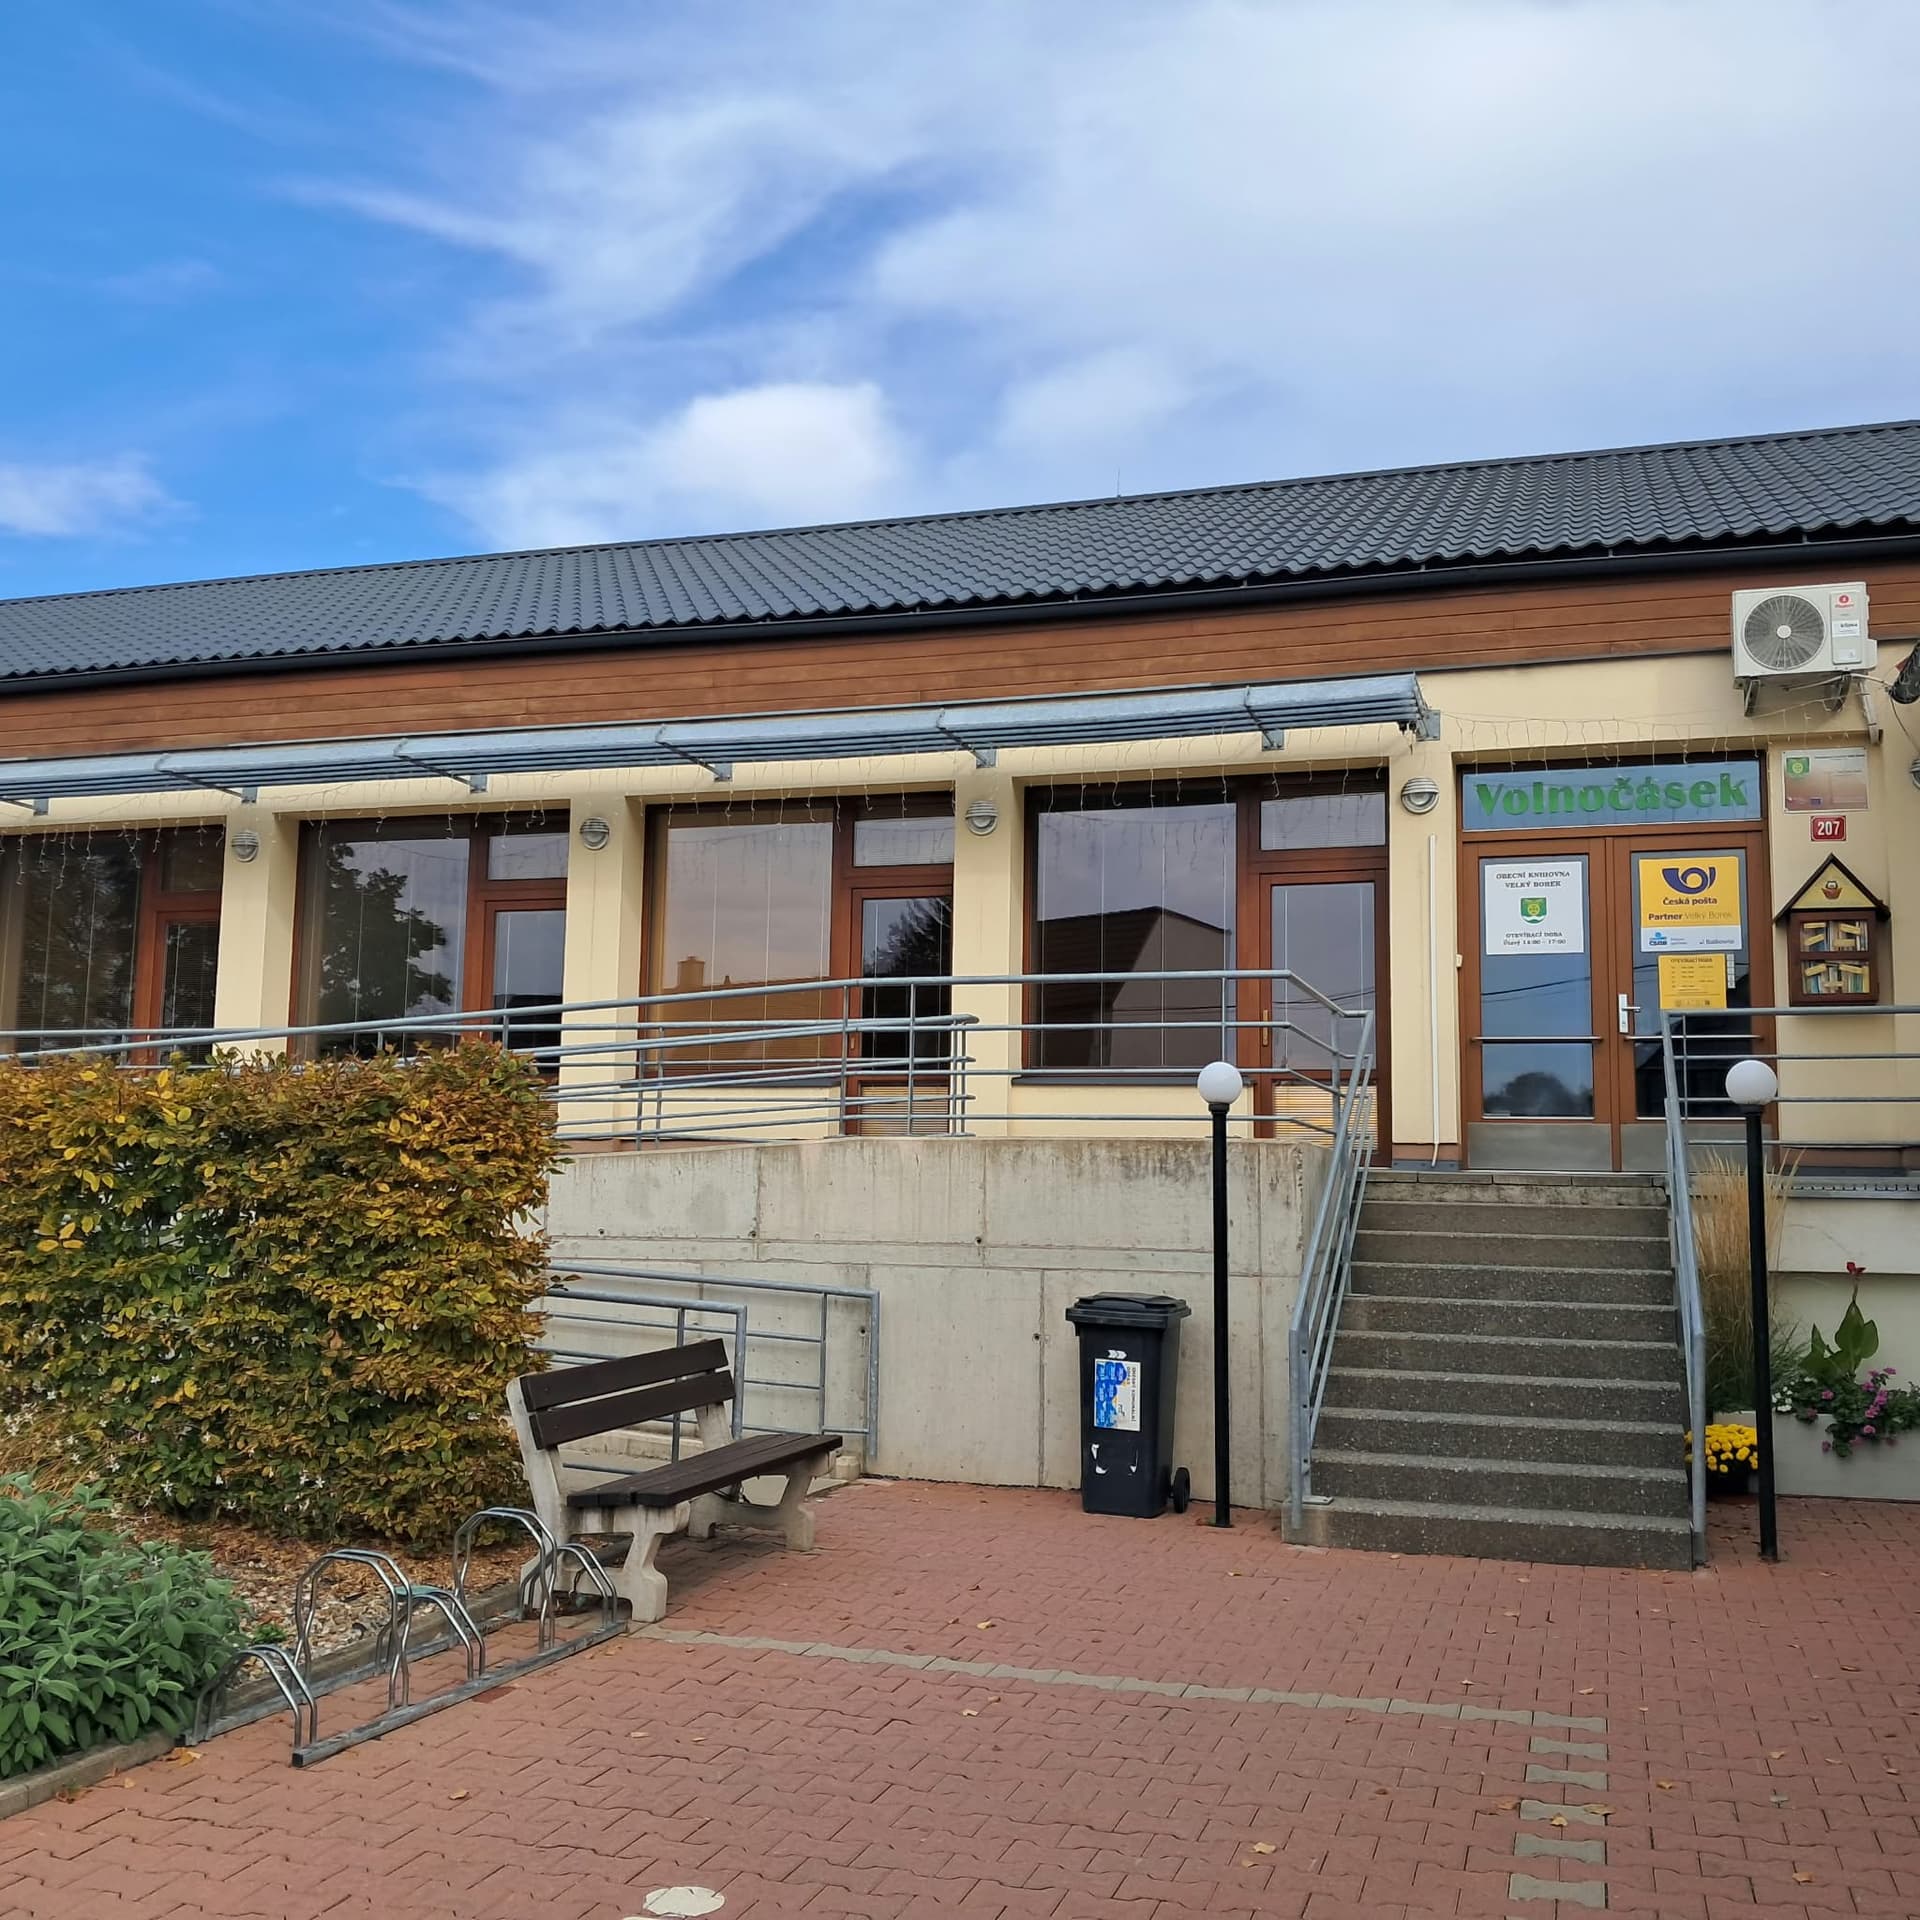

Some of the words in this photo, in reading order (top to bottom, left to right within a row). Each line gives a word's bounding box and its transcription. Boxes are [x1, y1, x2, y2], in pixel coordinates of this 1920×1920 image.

[1476, 773, 1748, 816] Volnočásek
[1817, 821, 1840, 836] 207
[1496, 871, 1526, 879] OBECNÍ
[1663, 897, 1690, 905] Česká
[1692, 897, 1717, 906] pošta
